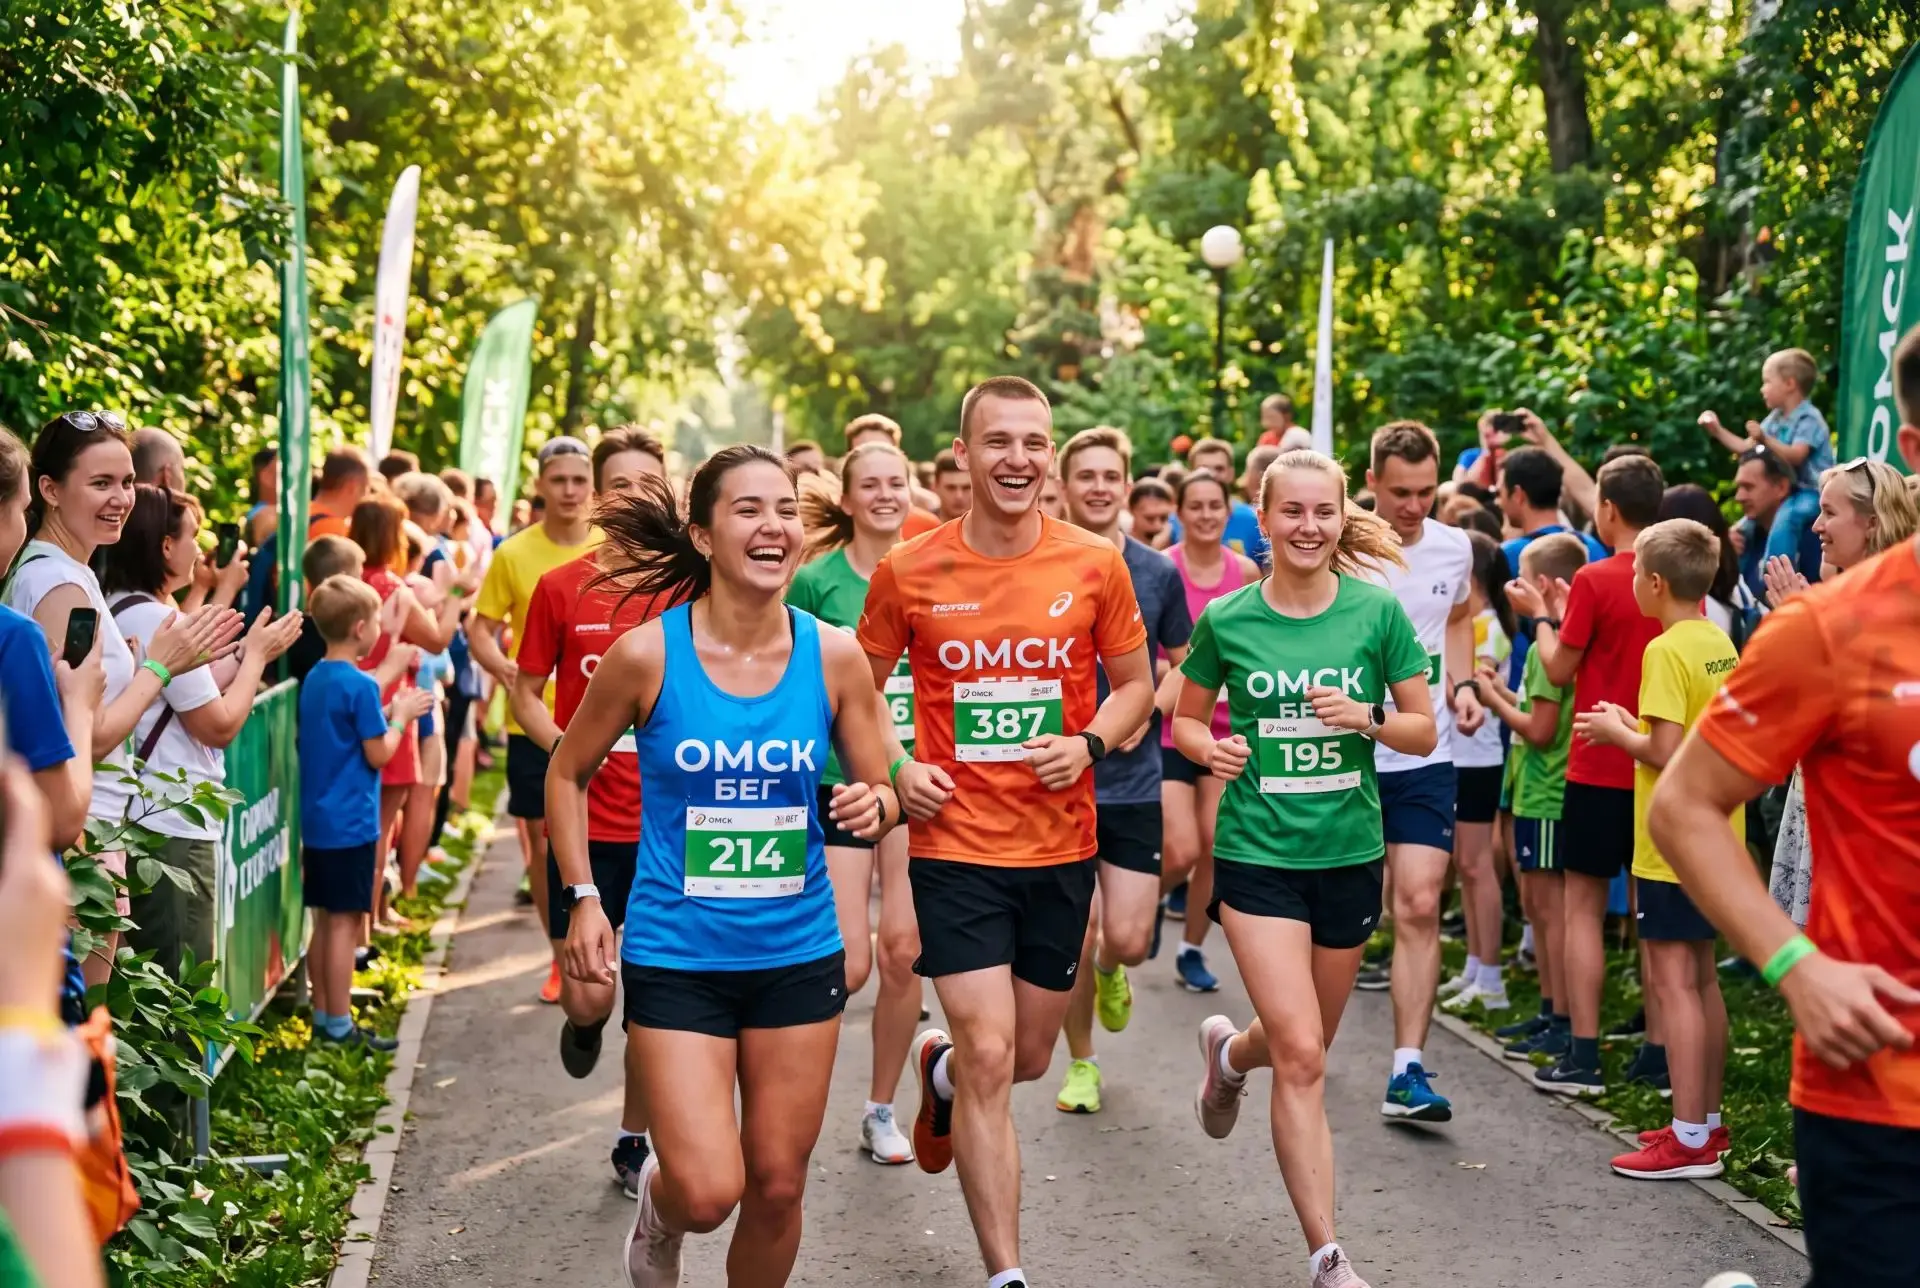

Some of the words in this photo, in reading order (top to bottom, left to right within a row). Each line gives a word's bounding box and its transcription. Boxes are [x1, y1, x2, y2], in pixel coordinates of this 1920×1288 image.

[1868, 205, 1914, 464] ОМСК
[938, 637, 1076, 671] ОМСК
[971, 690, 994, 698] ОМСК
[1246, 666, 1364, 699] ОМСК
[970, 706, 1047, 740] 387
[1279, 702, 1317, 719] БЕ
[674, 738, 816, 773] ОМСК
[1278, 741, 1343, 772] 195
[715, 778, 781, 801] БЕГ
[708, 817, 733, 825] ОМСК
[708, 837, 786, 873] 214
